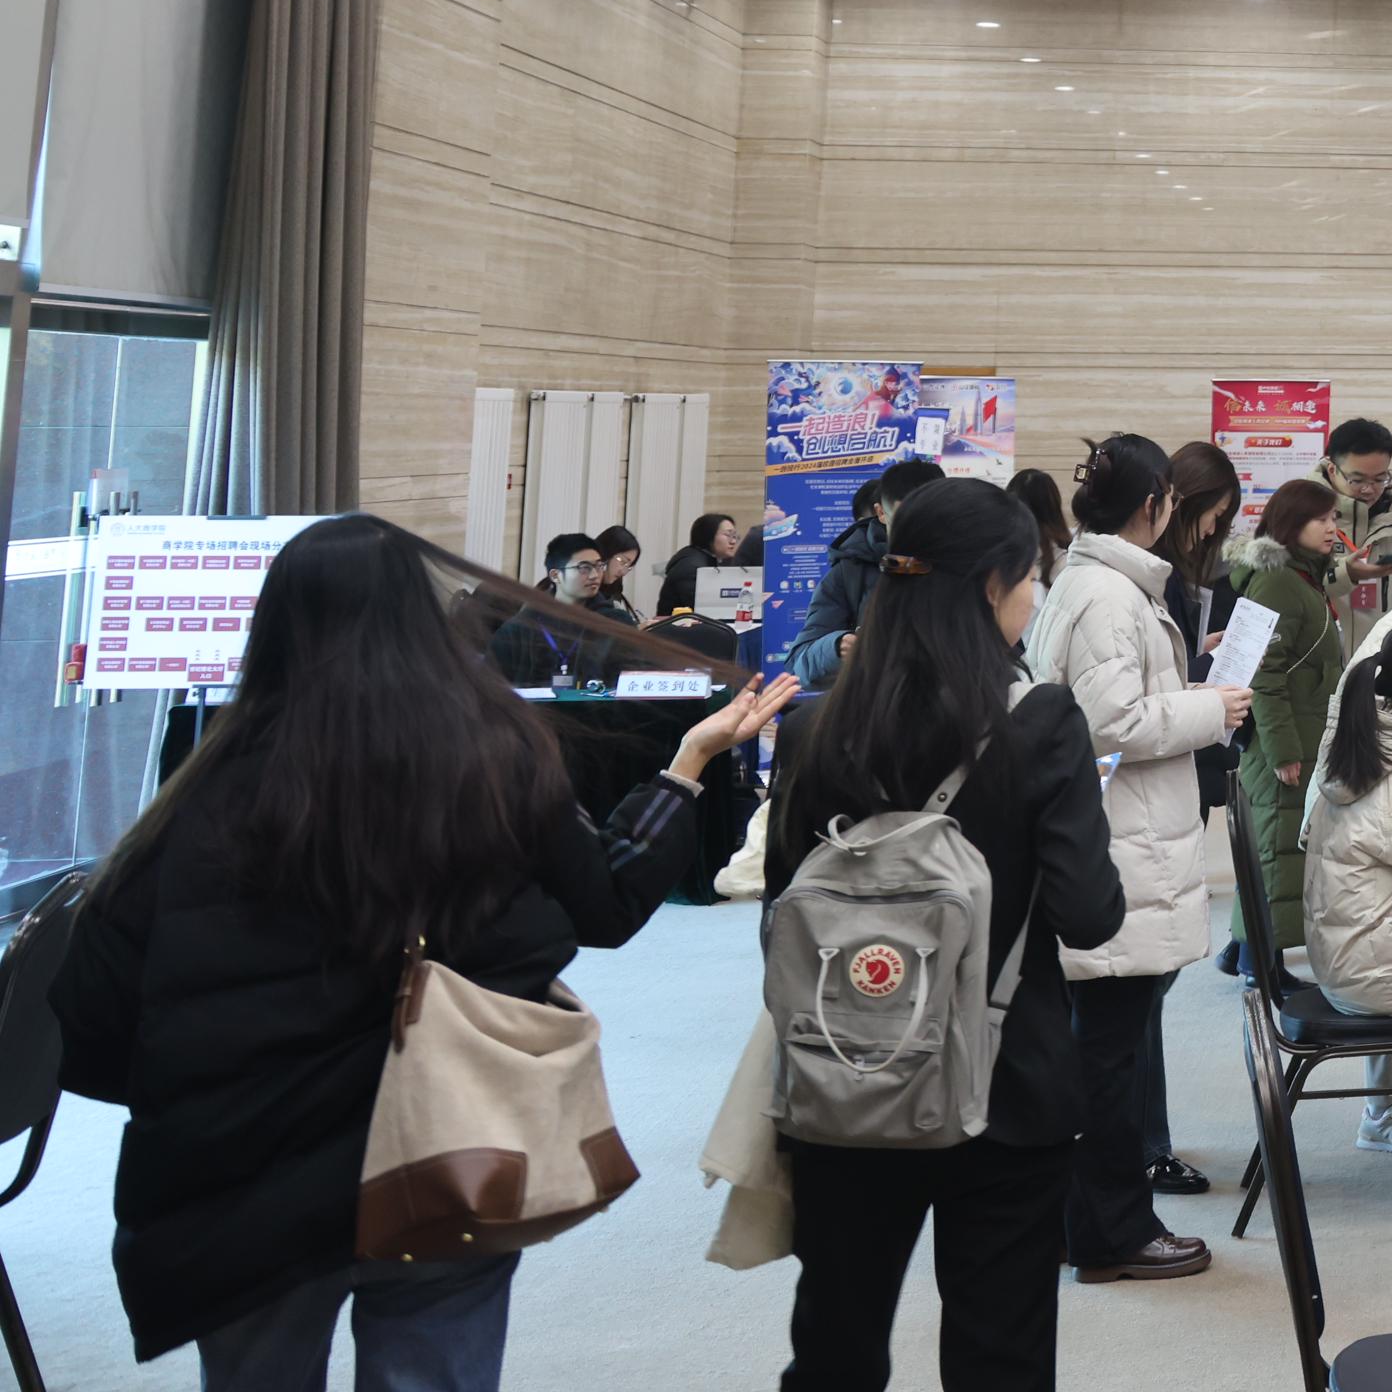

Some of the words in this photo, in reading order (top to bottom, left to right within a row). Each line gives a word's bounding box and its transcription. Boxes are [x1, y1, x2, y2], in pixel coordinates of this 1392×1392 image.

[162, 540, 287, 552] 商学院专场招聘会现场分
[628, 680, 700, 692] 企业签到处
